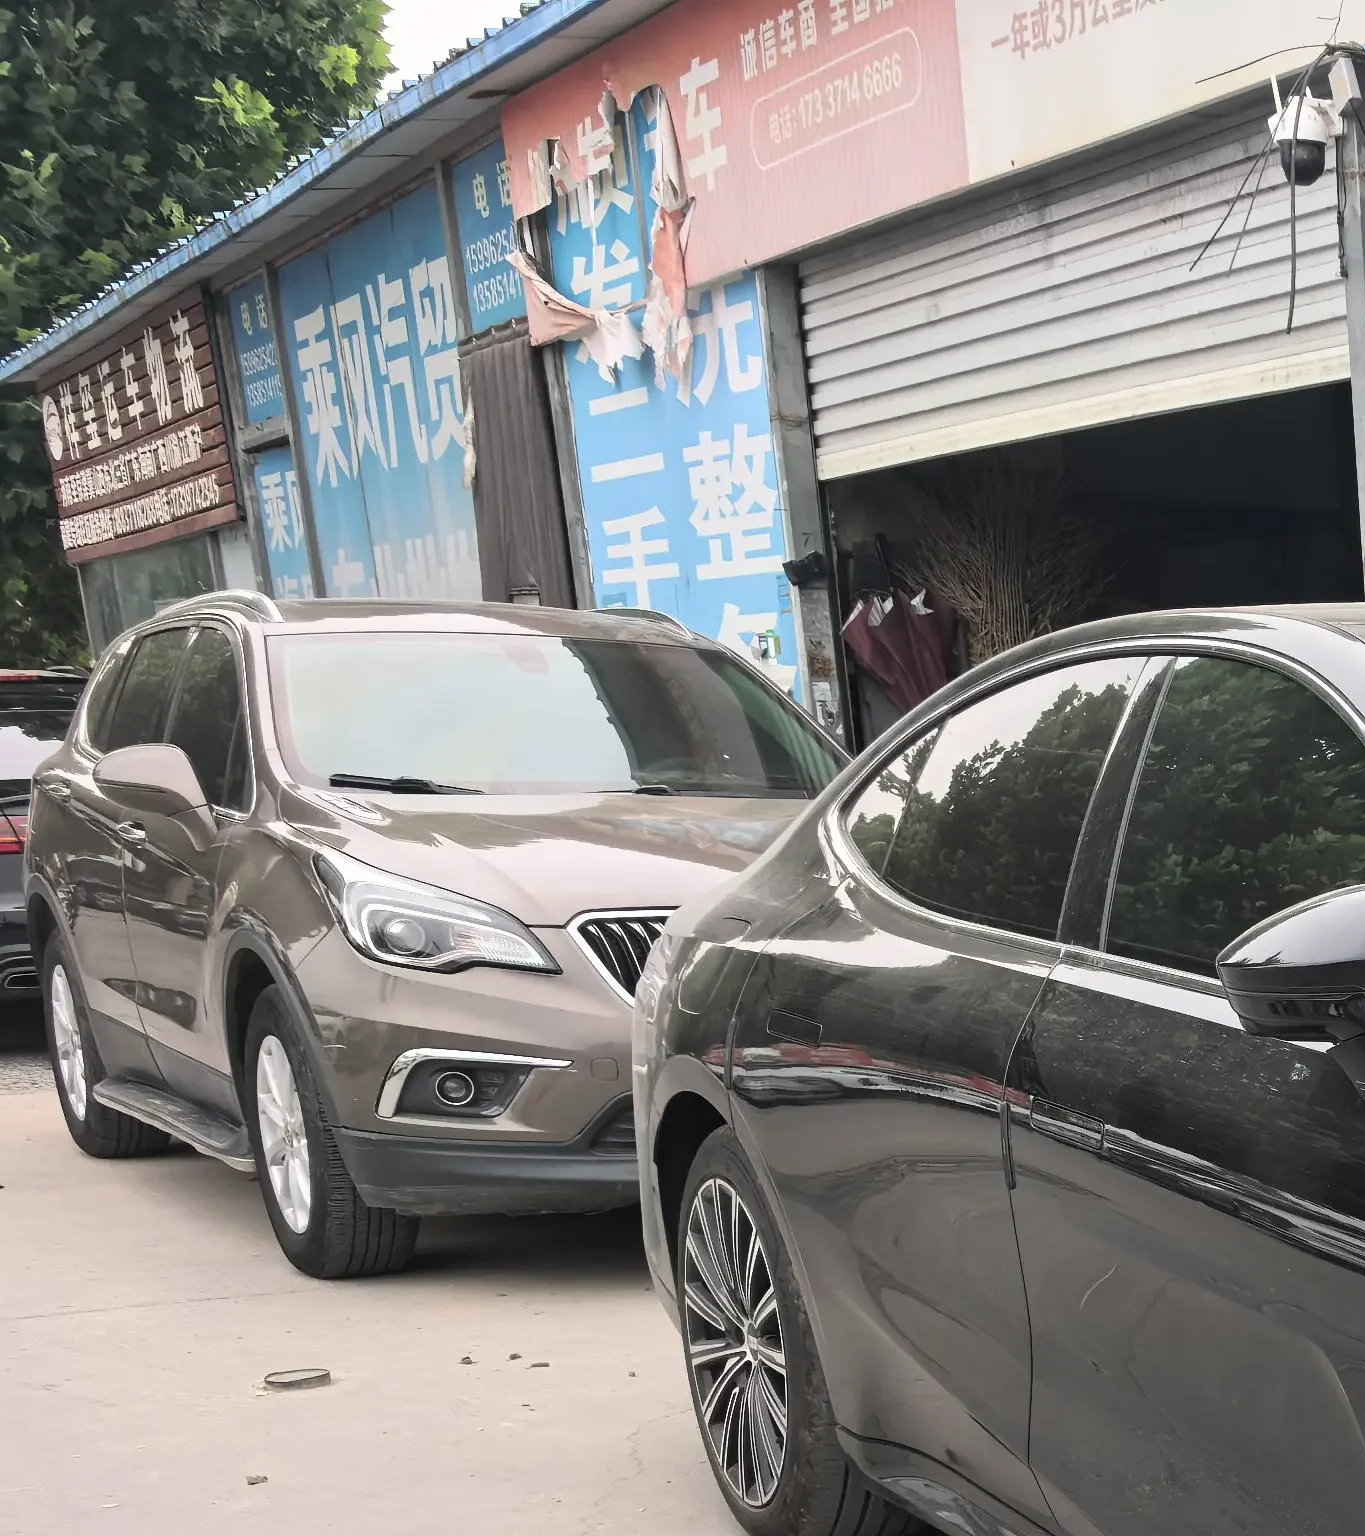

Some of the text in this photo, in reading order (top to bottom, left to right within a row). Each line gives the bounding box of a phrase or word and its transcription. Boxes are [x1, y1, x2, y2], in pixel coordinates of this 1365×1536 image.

[464, 224, 518, 275] 15996254
[472, 269, 525, 314] 13585141
[293, 255, 468, 489] 乘风汽贸
